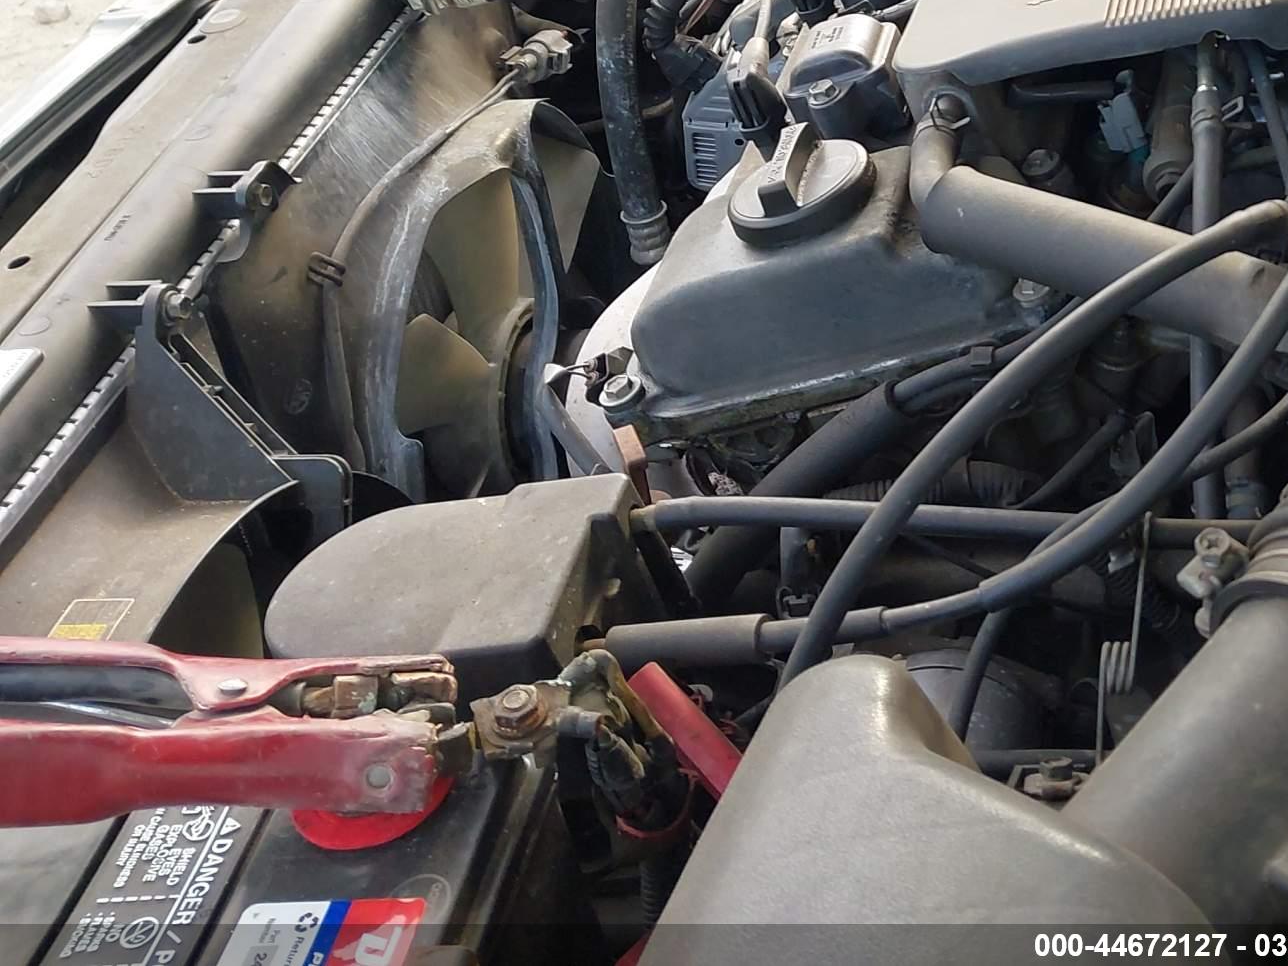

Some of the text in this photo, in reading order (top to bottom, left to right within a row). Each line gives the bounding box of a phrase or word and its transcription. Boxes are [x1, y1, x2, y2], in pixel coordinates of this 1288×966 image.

[141, 824, 170, 861] GASES
[142, 824, 183, 882] EXPLOSIVE
[158, 848, 182, 876] EYES
[166, 847, 196, 885] SHIELD
[172, 838, 233, 925] DANGER
[105, 924, 125, 943] NO
